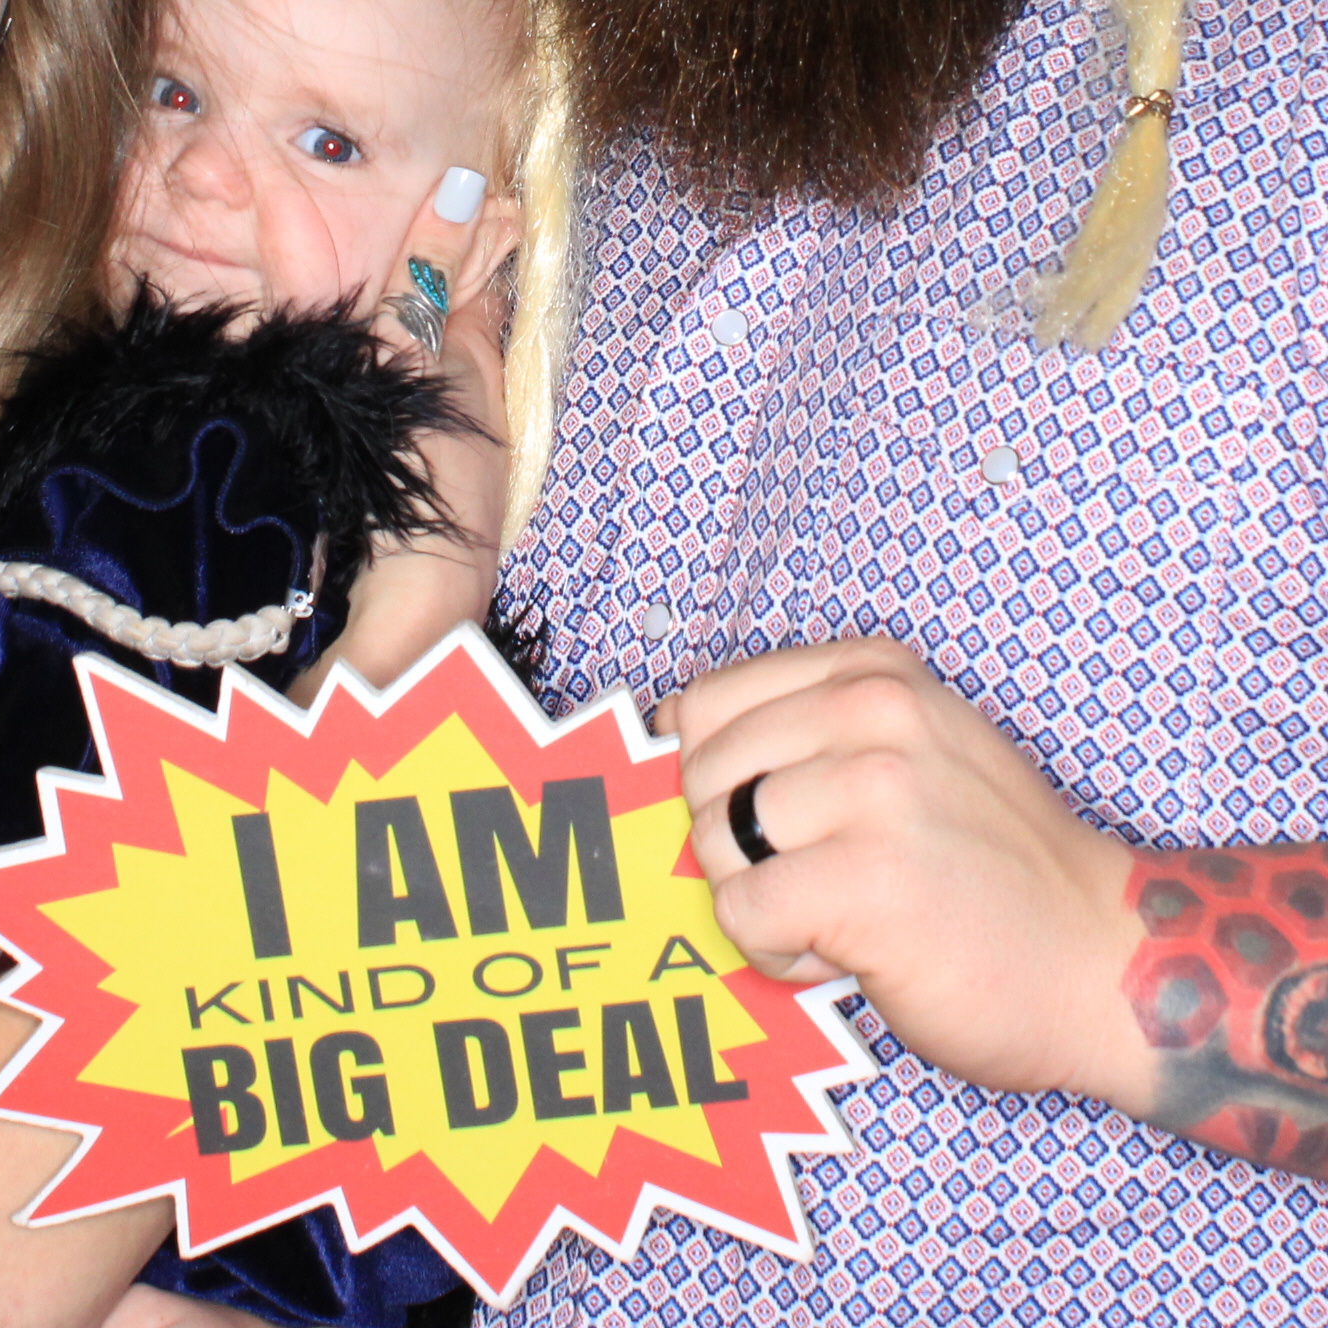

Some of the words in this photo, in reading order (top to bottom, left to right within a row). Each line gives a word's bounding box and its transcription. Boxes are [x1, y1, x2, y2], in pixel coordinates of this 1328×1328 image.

[231, 812, 293, 959] I
[354, 776, 625, 948] AM
[184, 964, 436, 1030] KIND
[472, 942, 614, 999] OF
[649, 935, 716, 982] A
[181, 1031, 395, 1156] BIG
[432, 994, 749, 1130] DEAL
